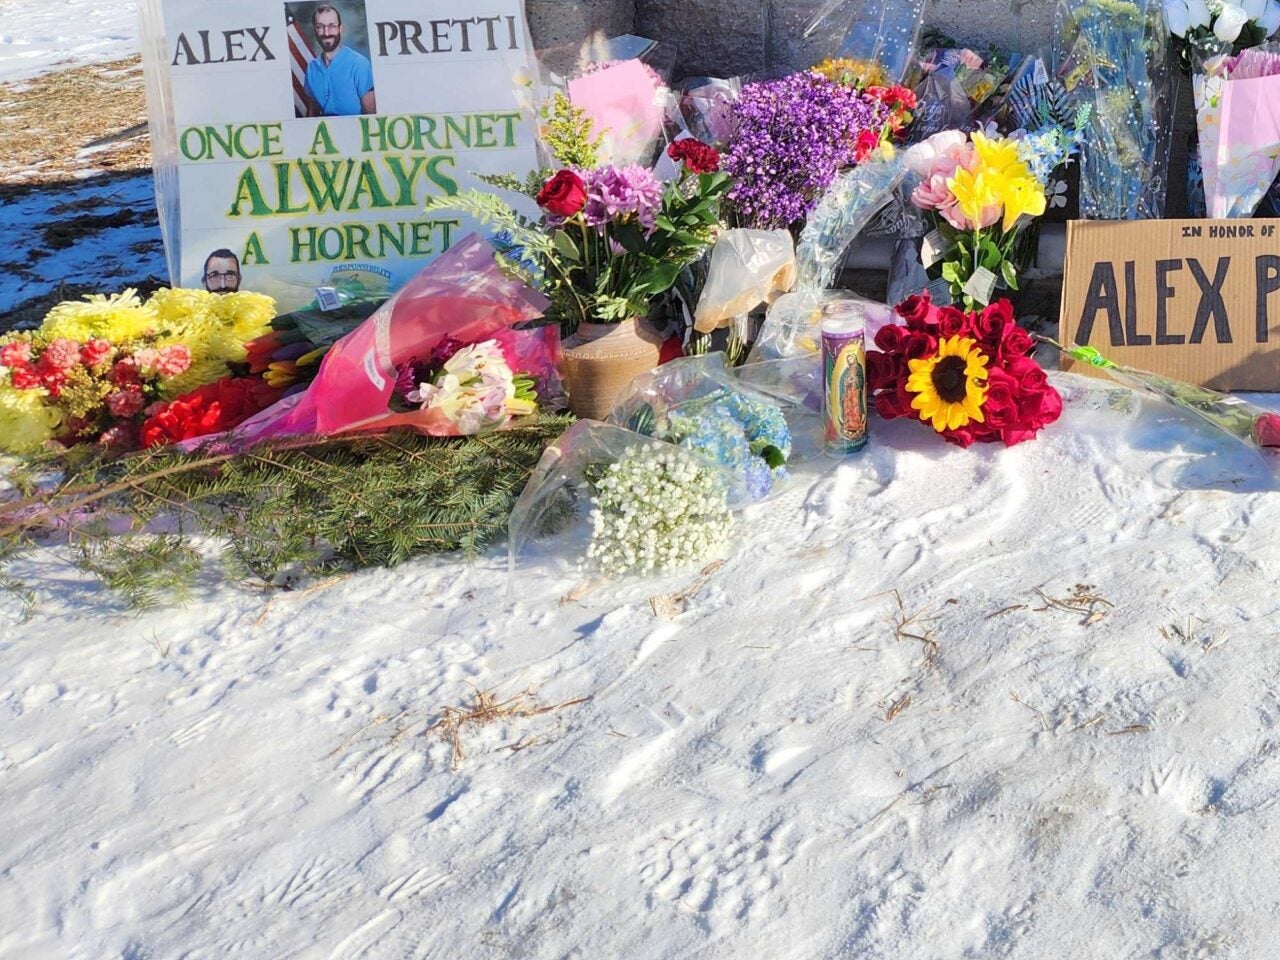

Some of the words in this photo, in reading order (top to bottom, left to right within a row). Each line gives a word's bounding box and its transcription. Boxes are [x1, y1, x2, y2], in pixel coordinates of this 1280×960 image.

[171, 26, 276, 66] ALEX
[374, 15, 521, 57] PRETTI
[178, 123, 283, 161] ONCE
[310, 121, 338, 156] A
[359, 113, 522, 151] HORNET
[227, 155, 459, 218] ALWAYS
[241, 233, 270, 266] A
[289, 220, 459, 265] HORNET
[1182, 226, 1200, 238] IN
[1208, 226, 1254, 239] HONOR
[1260, 225, 1275, 238] OF
[1075, 256, 1231, 347] ALEX
